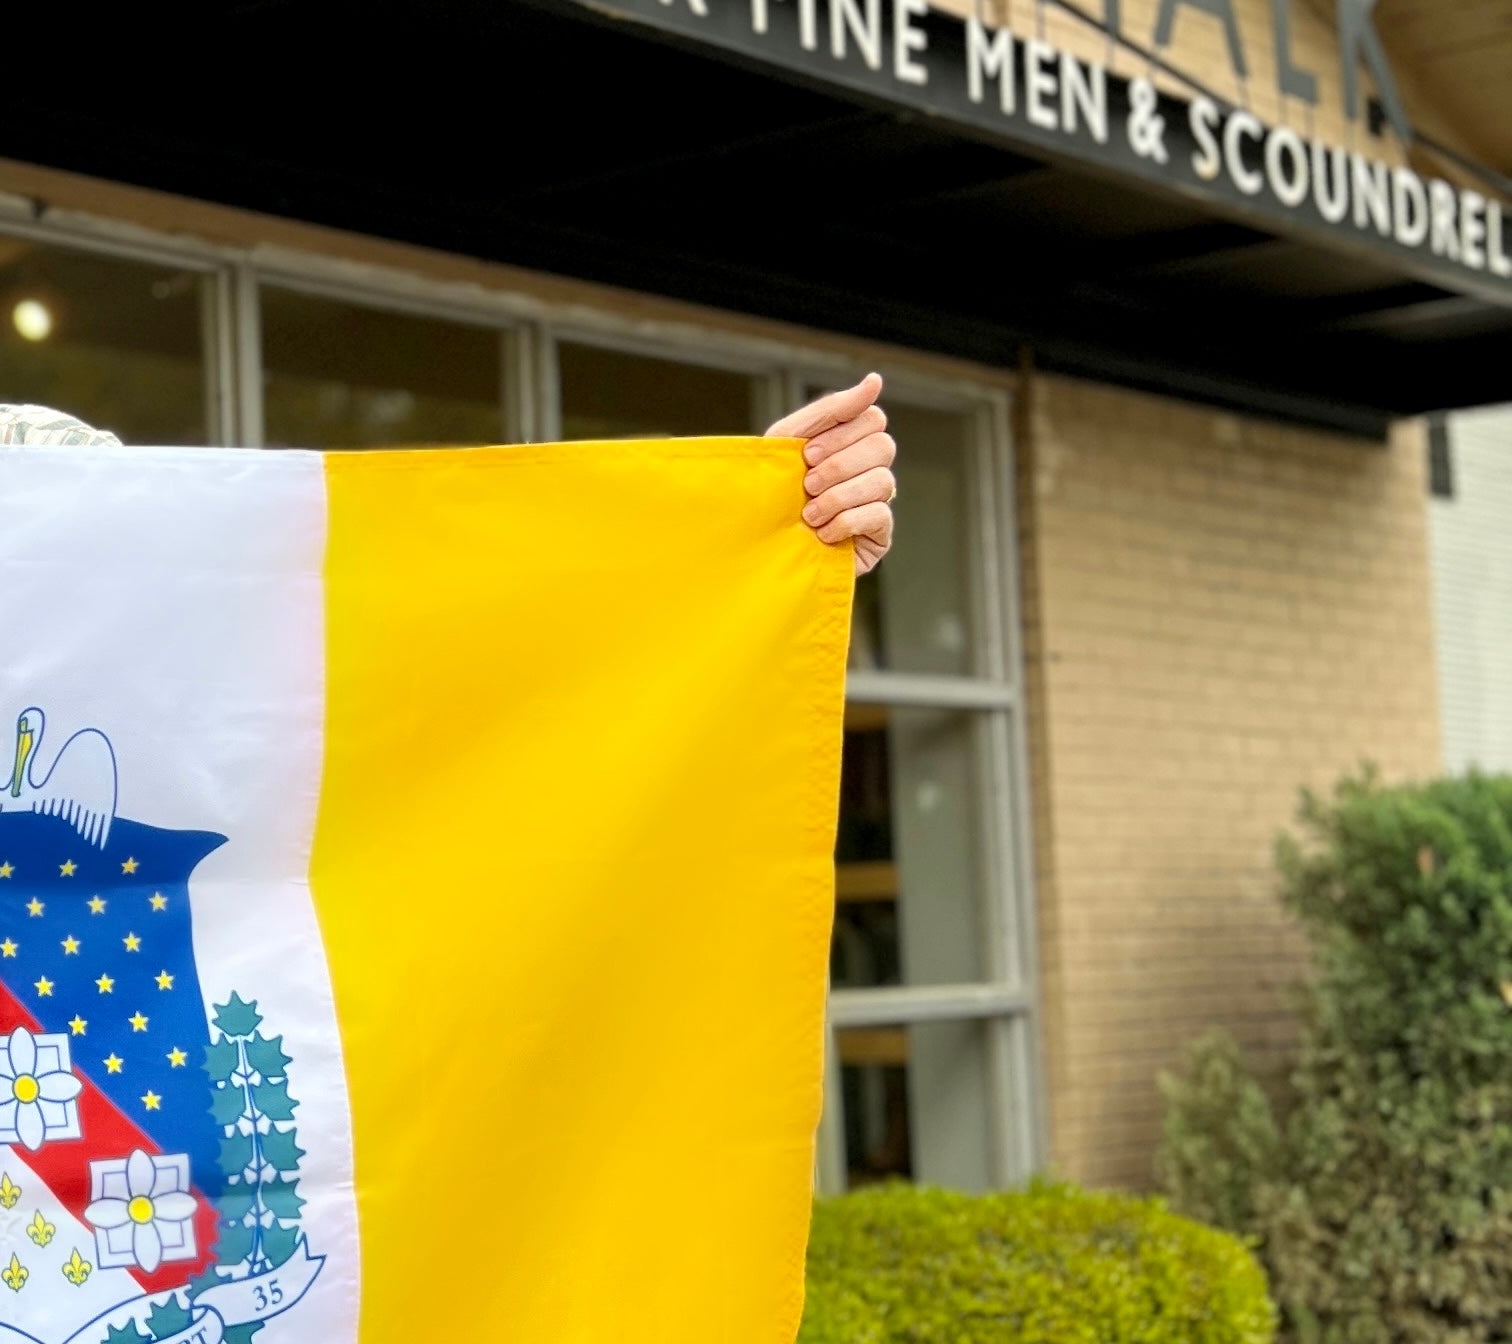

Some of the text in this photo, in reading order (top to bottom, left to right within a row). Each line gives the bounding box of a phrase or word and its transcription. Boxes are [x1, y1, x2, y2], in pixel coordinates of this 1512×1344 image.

[965, 17, 1109, 144] MEN
[1126, 78, 1169, 164] &
[1189, 95, 1512, 278] SCOUNDREL
[253, 1283, 285, 1313] 35
